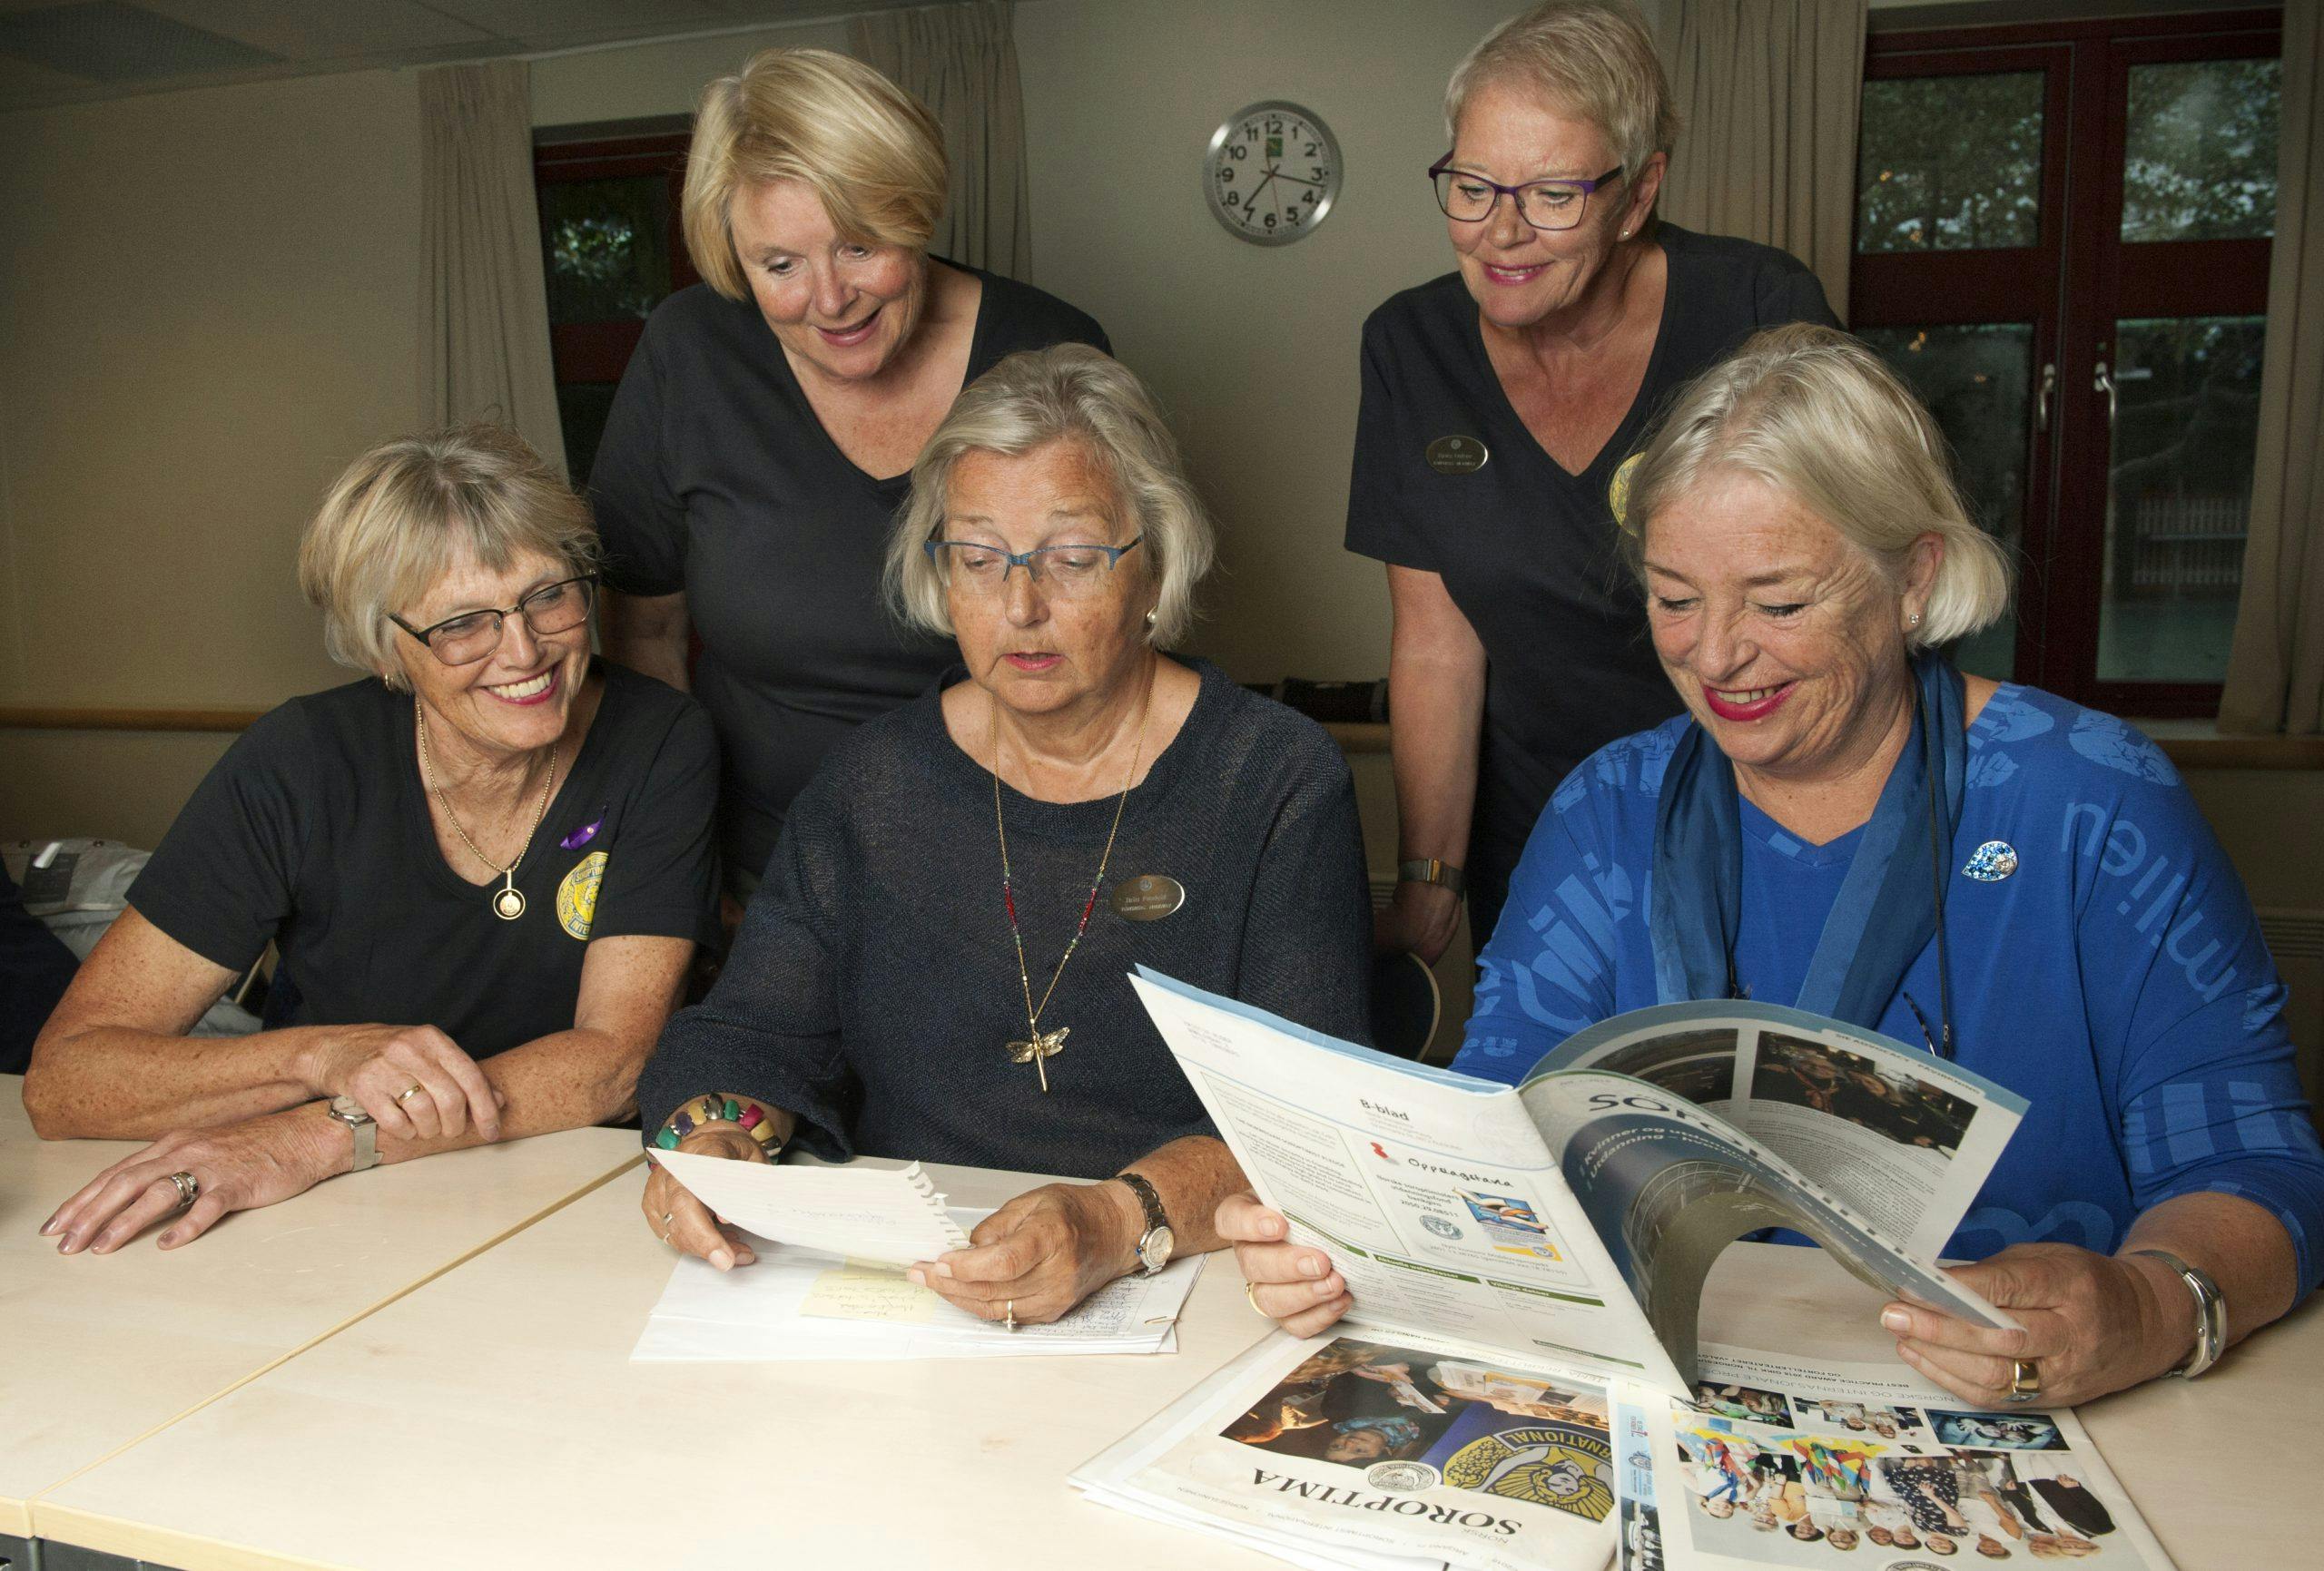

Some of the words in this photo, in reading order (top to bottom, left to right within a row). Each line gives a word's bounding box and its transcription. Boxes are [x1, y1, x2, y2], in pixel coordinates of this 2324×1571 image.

[1246, 127, 1258, 141] 11
[1265, 121, 1283, 134] 12
[1292, 126, 1298, 139] 1
[1229, 145, 1246, 160] 10
[1305, 143, 1316, 157] 2
[1222, 167, 1234, 182] 9
[1312, 167, 1323, 181] 3
[1227, 191, 1239, 206] 8
[1302, 190, 1314, 203] 4
[1244, 207, 1256, 221] 7
[1264, 213, 1276, 228] 6
[1286, 207, 1298, 221] 5
[1360, 1099, 1410, 1121] B-blad
[1584, 1128, 1639, 1166] Kvinner
[1590, 1134, 1664, 1178] Utdanning
[1254, 1468, 1521, 1535] SOROPTIMA
